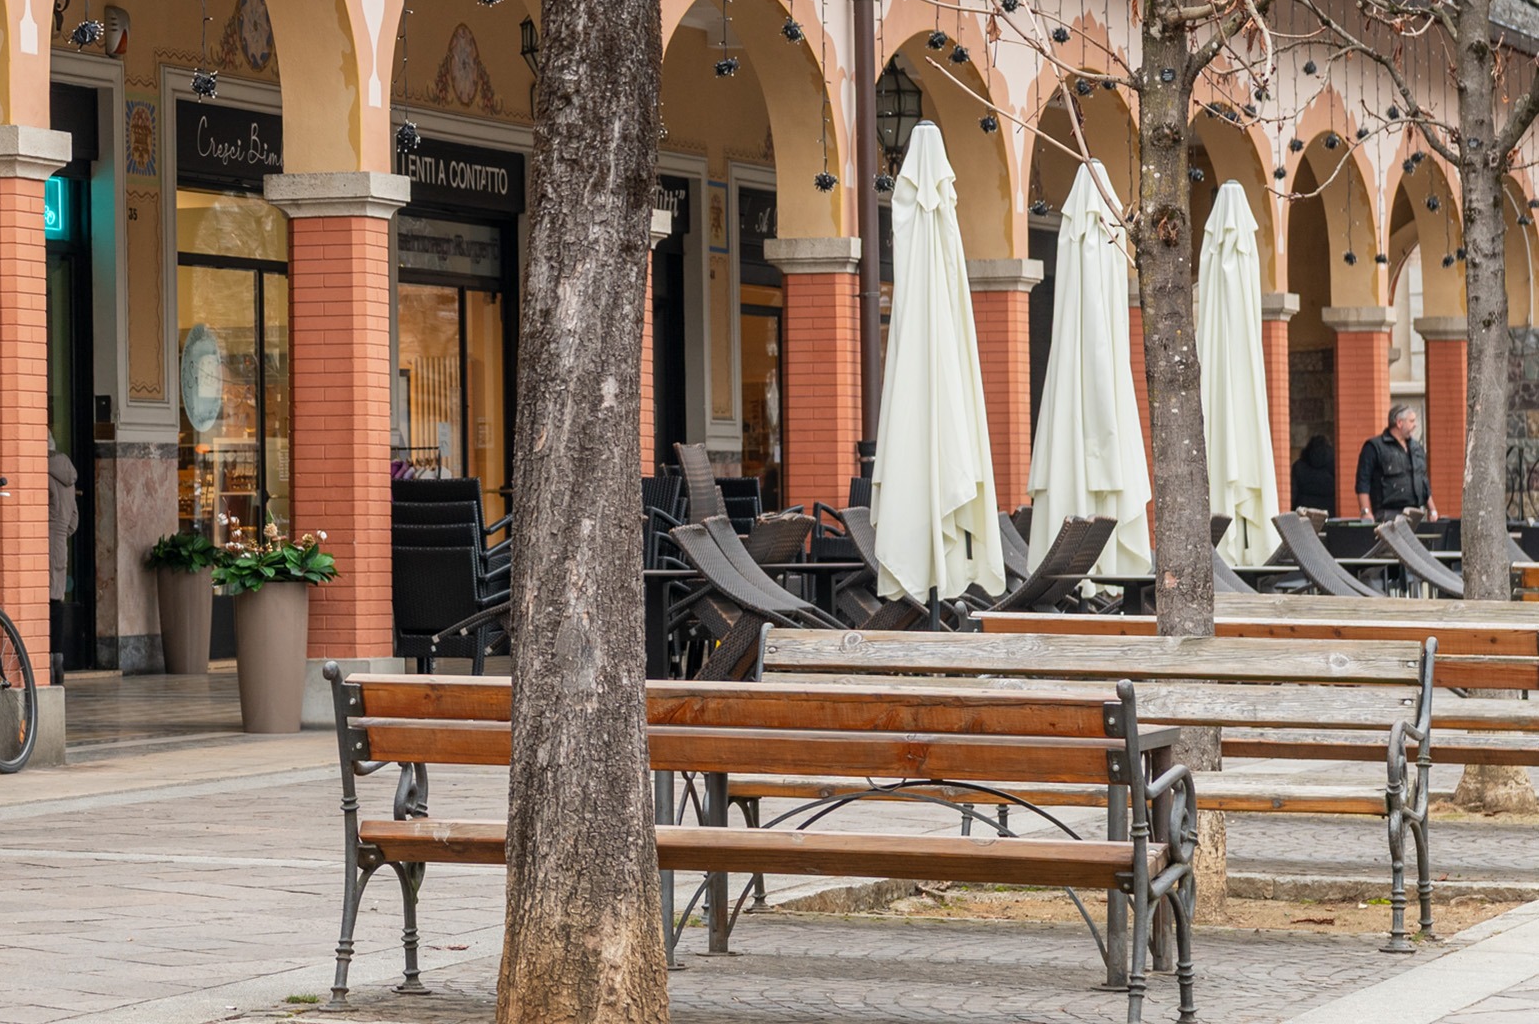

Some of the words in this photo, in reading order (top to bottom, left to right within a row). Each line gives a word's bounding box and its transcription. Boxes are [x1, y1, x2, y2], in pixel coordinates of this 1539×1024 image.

[197, 115, 246, 166] Cresci
[247, 122, 283, 166] Bim
[437, 159, 447, 187] A
[449, 160, 509, 196] CONTATTO
